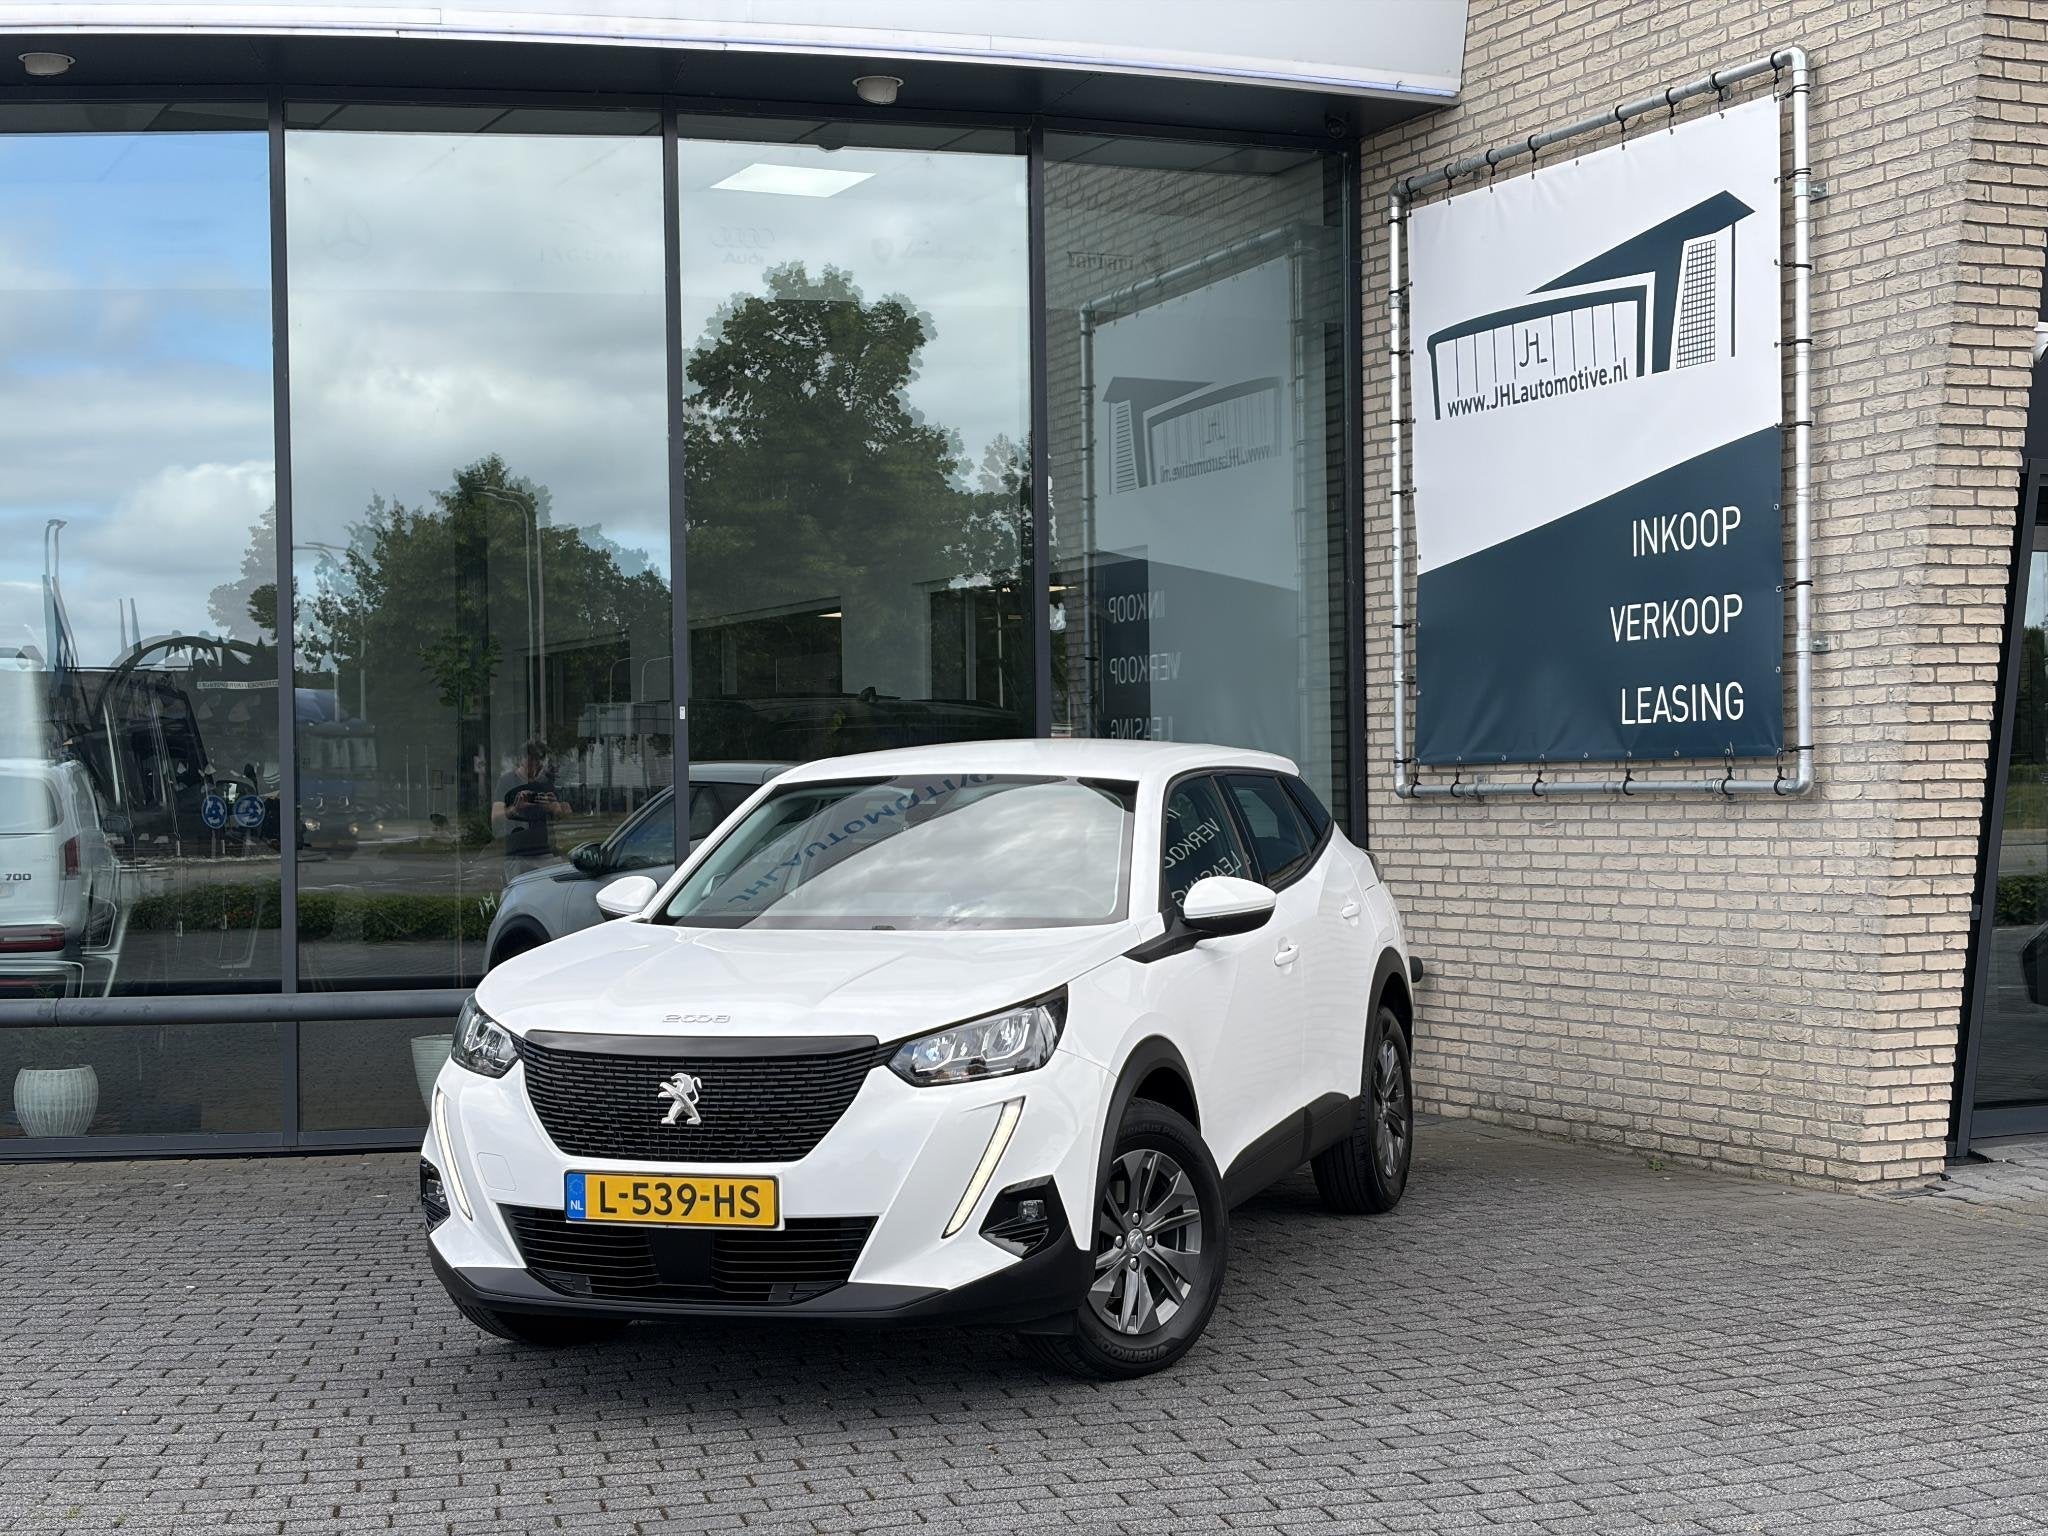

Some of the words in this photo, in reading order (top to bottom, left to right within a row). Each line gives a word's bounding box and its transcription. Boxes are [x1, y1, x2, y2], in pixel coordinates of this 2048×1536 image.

[1447, 357, 1628, 418] www.JHLautomotive.nl
[1632, 505, 1742, 558] INKOOP
[1609, 593, 1744, 643] VERKOOP
[1621, 680, 1745, 726] LEASING
[662, 1014, 731, 1024] 2008
[570, 1201, 584, 1211] NL
[599, 1181, 761, 1219] L-539-HS
